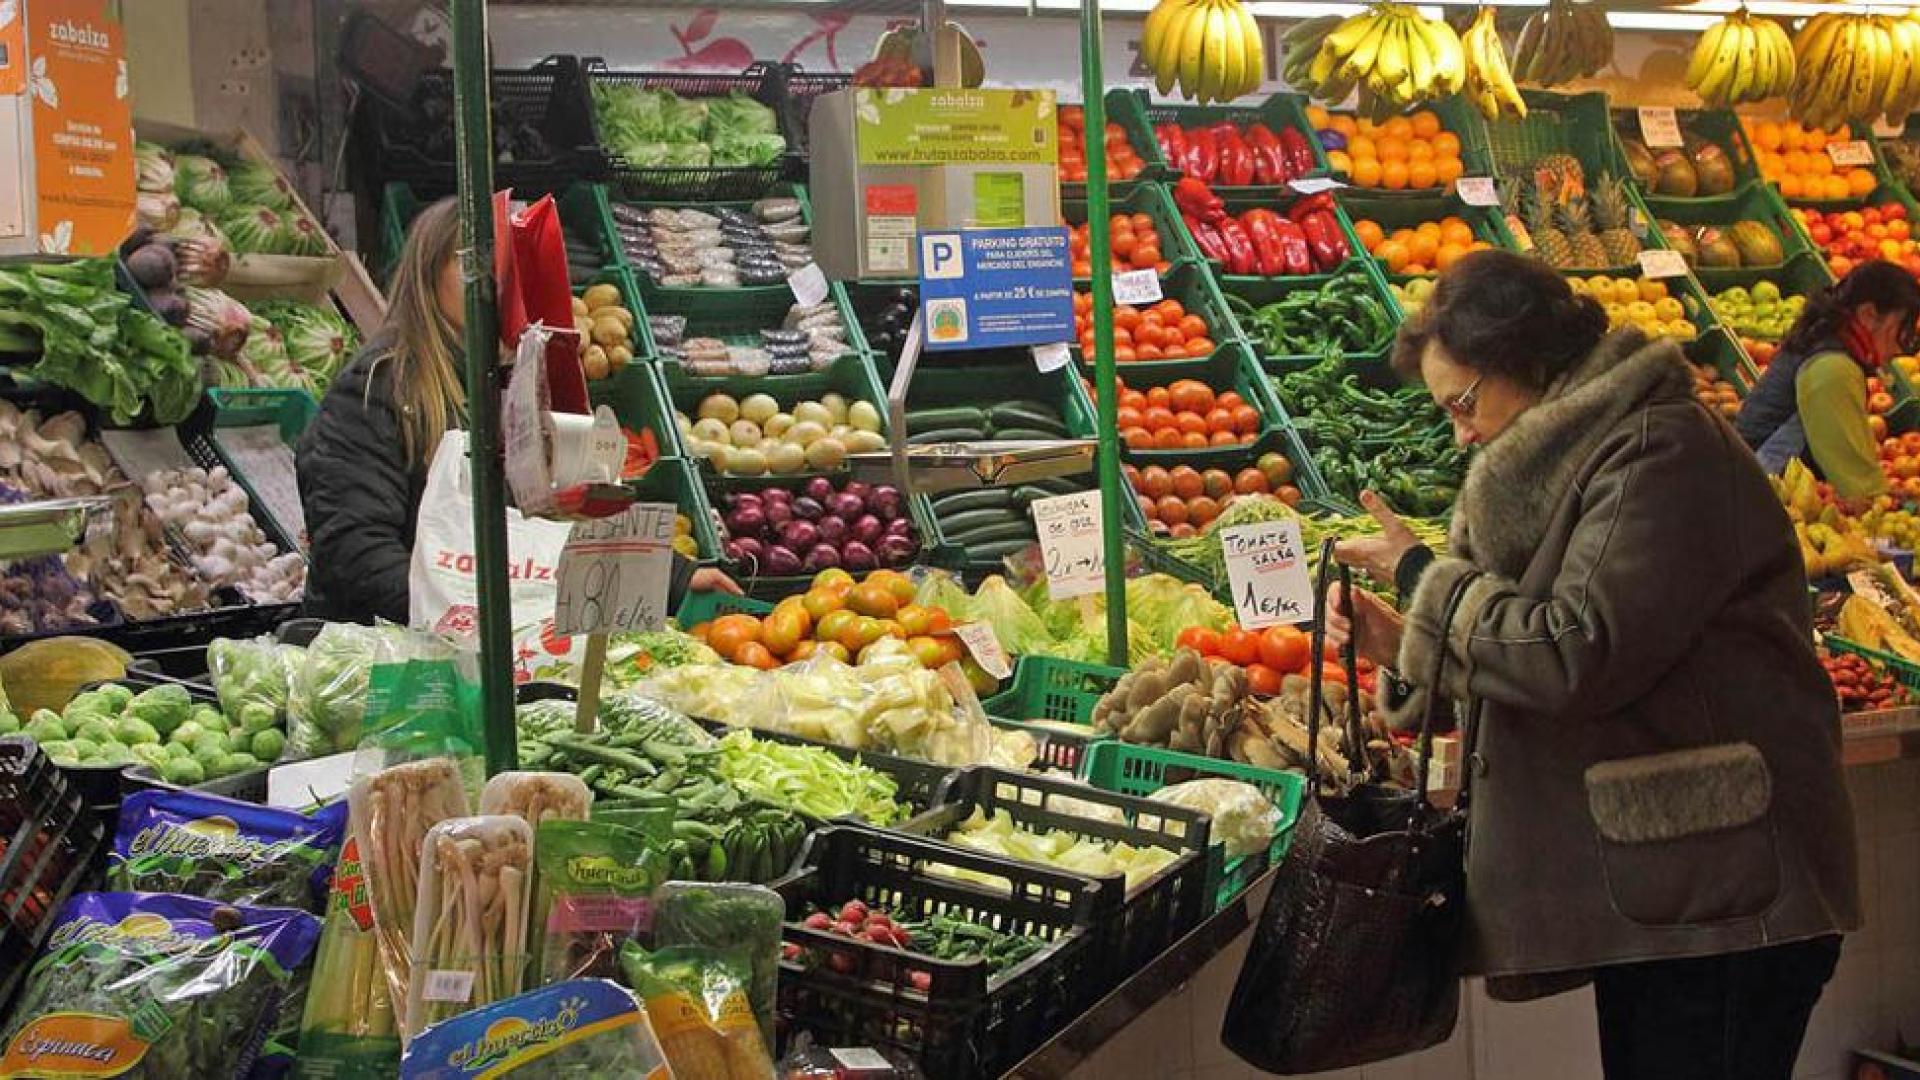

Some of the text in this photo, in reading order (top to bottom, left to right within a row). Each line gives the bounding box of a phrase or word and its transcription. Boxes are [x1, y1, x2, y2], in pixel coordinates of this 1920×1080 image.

[929, 93, 984, 107] zabalza
[874, 148, 1041, 161] www.frutaszabalza.com
[972, 237, 1065, 249] PARKING GRATUITO
[932, 242, 953, 272] P
[1014, 286, 1027, 299] 25
[1224, 531, 1289, 553] TOMATE
